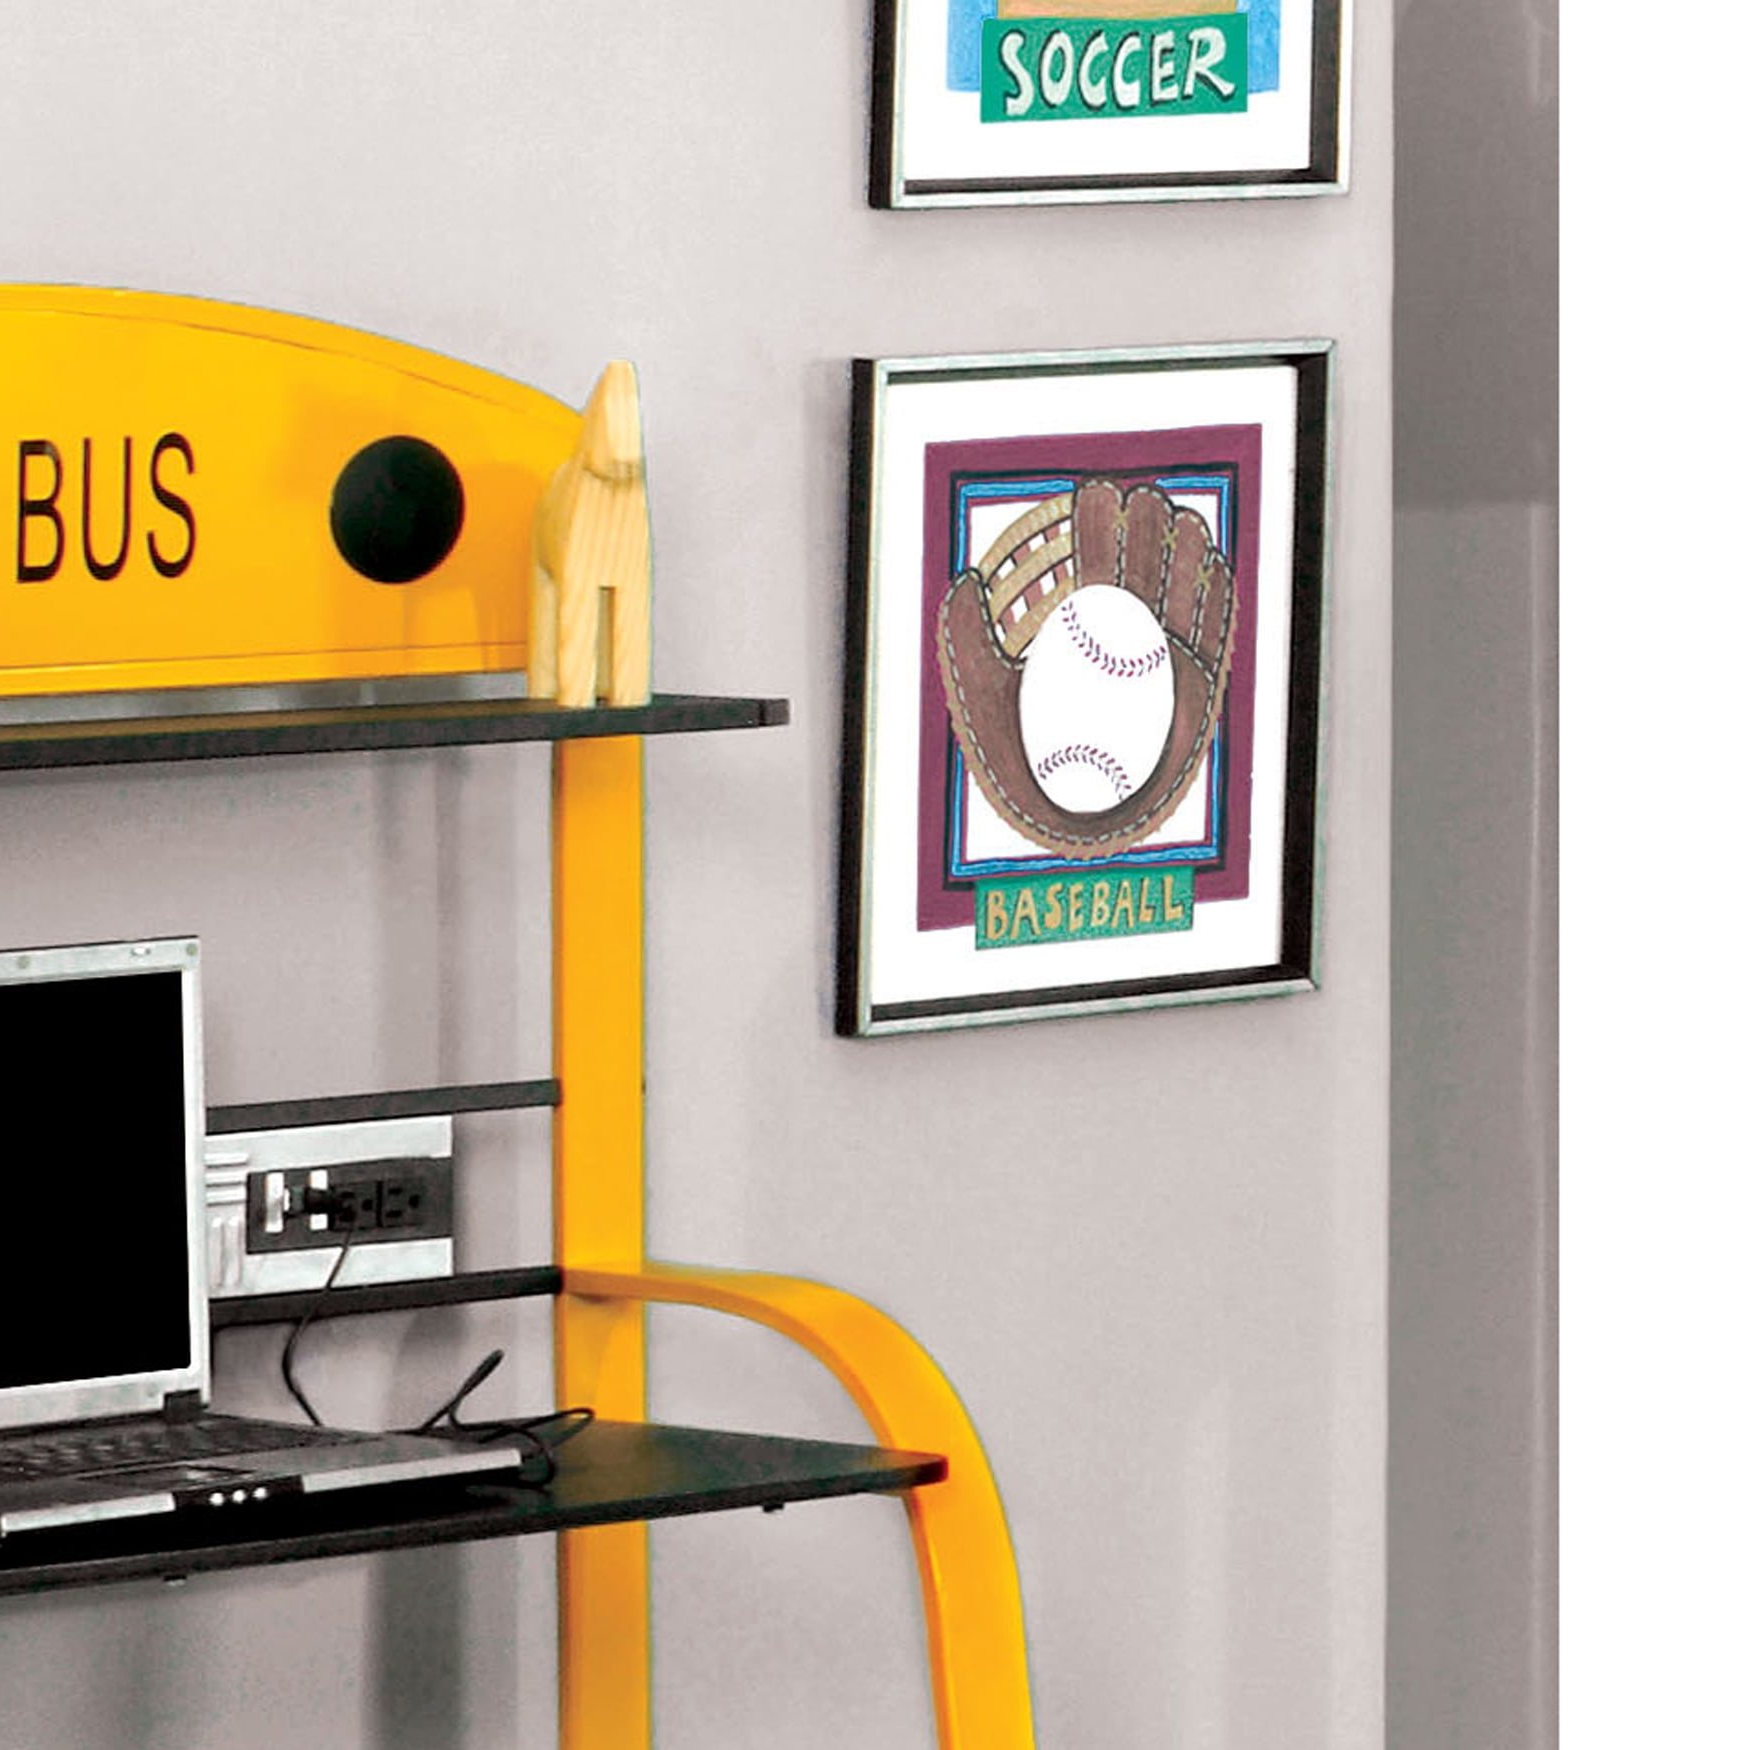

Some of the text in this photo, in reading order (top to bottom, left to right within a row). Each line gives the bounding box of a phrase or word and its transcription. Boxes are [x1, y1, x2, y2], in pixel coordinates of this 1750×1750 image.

[1000, 27, 1236, 116] SOCCER
[17, 431, 197, 583] BUS
[986, 875, 1183, 941] BASEBALL
